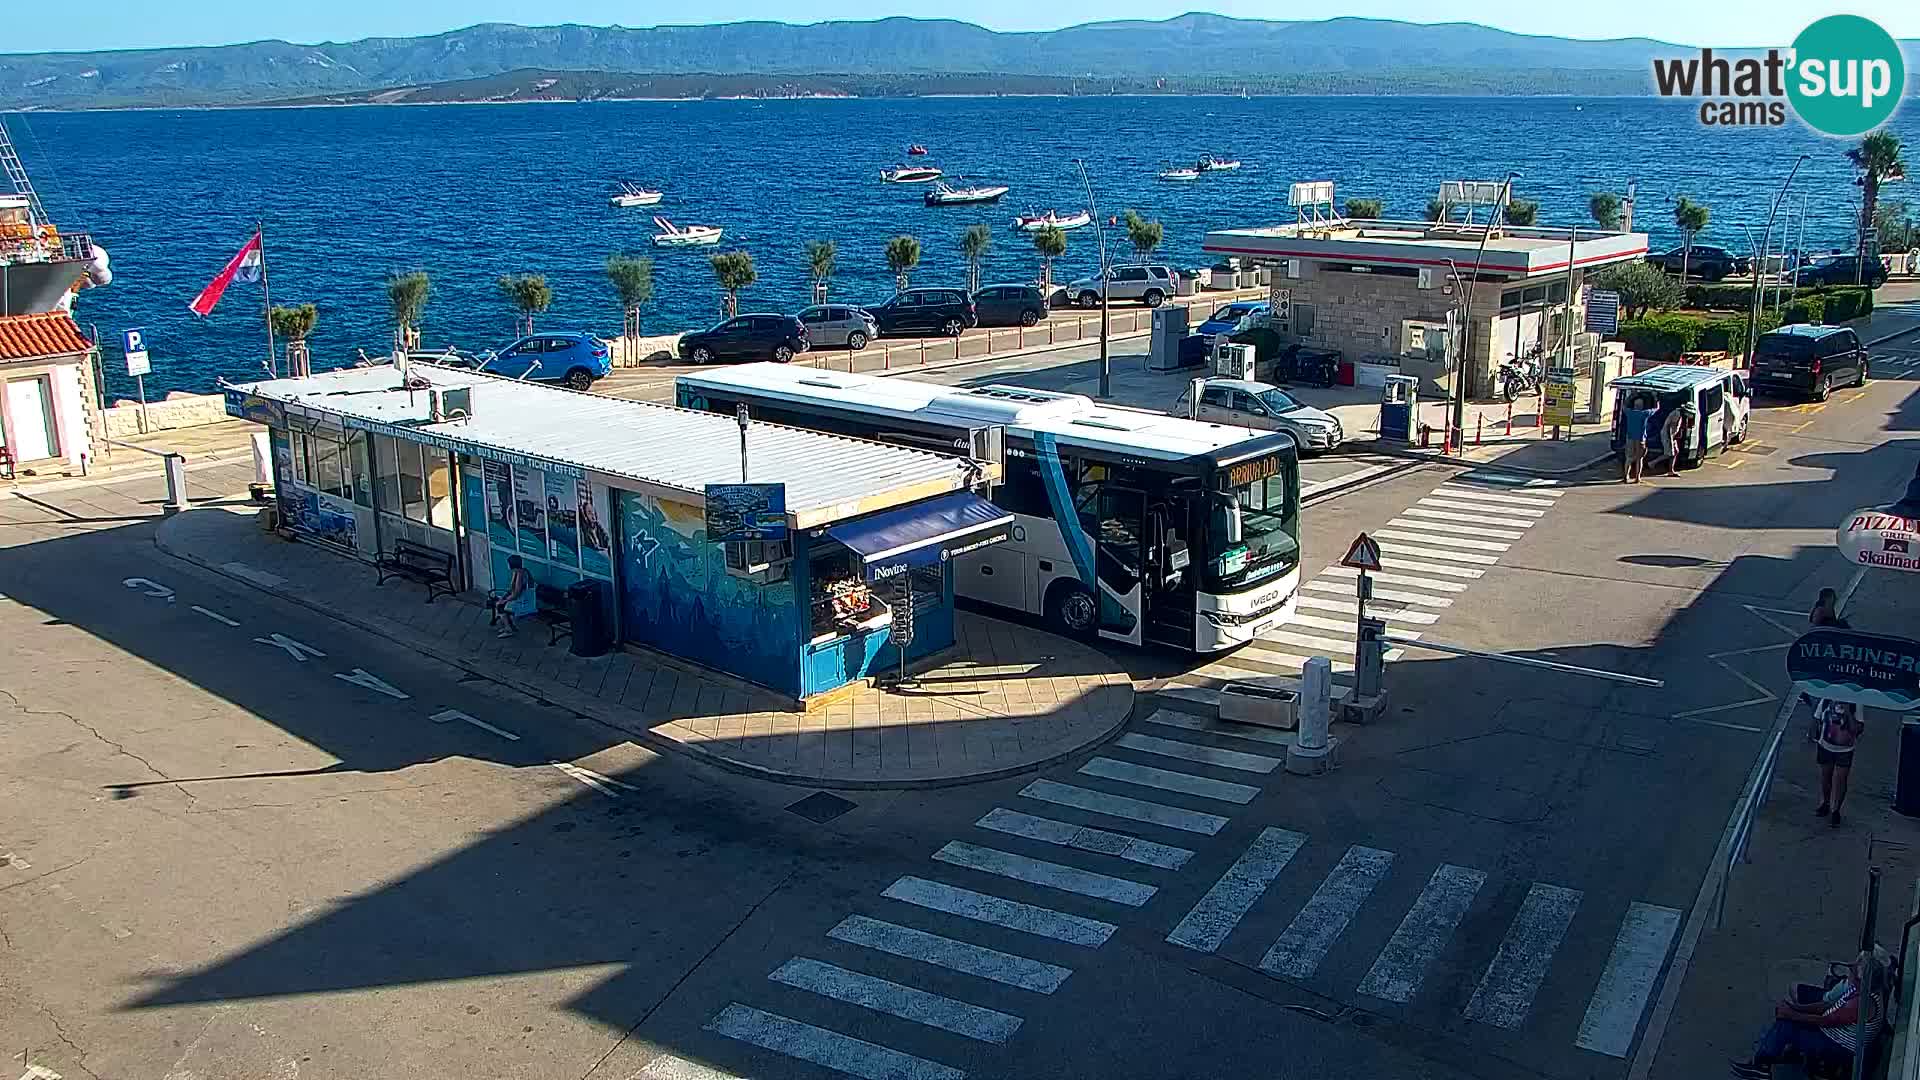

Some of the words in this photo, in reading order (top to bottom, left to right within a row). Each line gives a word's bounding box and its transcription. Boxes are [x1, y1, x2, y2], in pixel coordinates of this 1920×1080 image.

[128, 331, 142, 351] P
[436, 437, 467, 453] POSTAJA
[477, 448, 491, 459] BUS
[493, 450, 525, 466] STATION
[528, 457, 552, 472] TICKET
[554, 462, 582, 478] OFFICE
[1231, 461, 1263, 488] ARRIVA
[1848, 516, 1920, 533] PIZZE
[1881, 530, 1914, 541] GRILL
[1250, 590, 1279, 609] IVECO
[1870, 666, 1896, 680] bar
